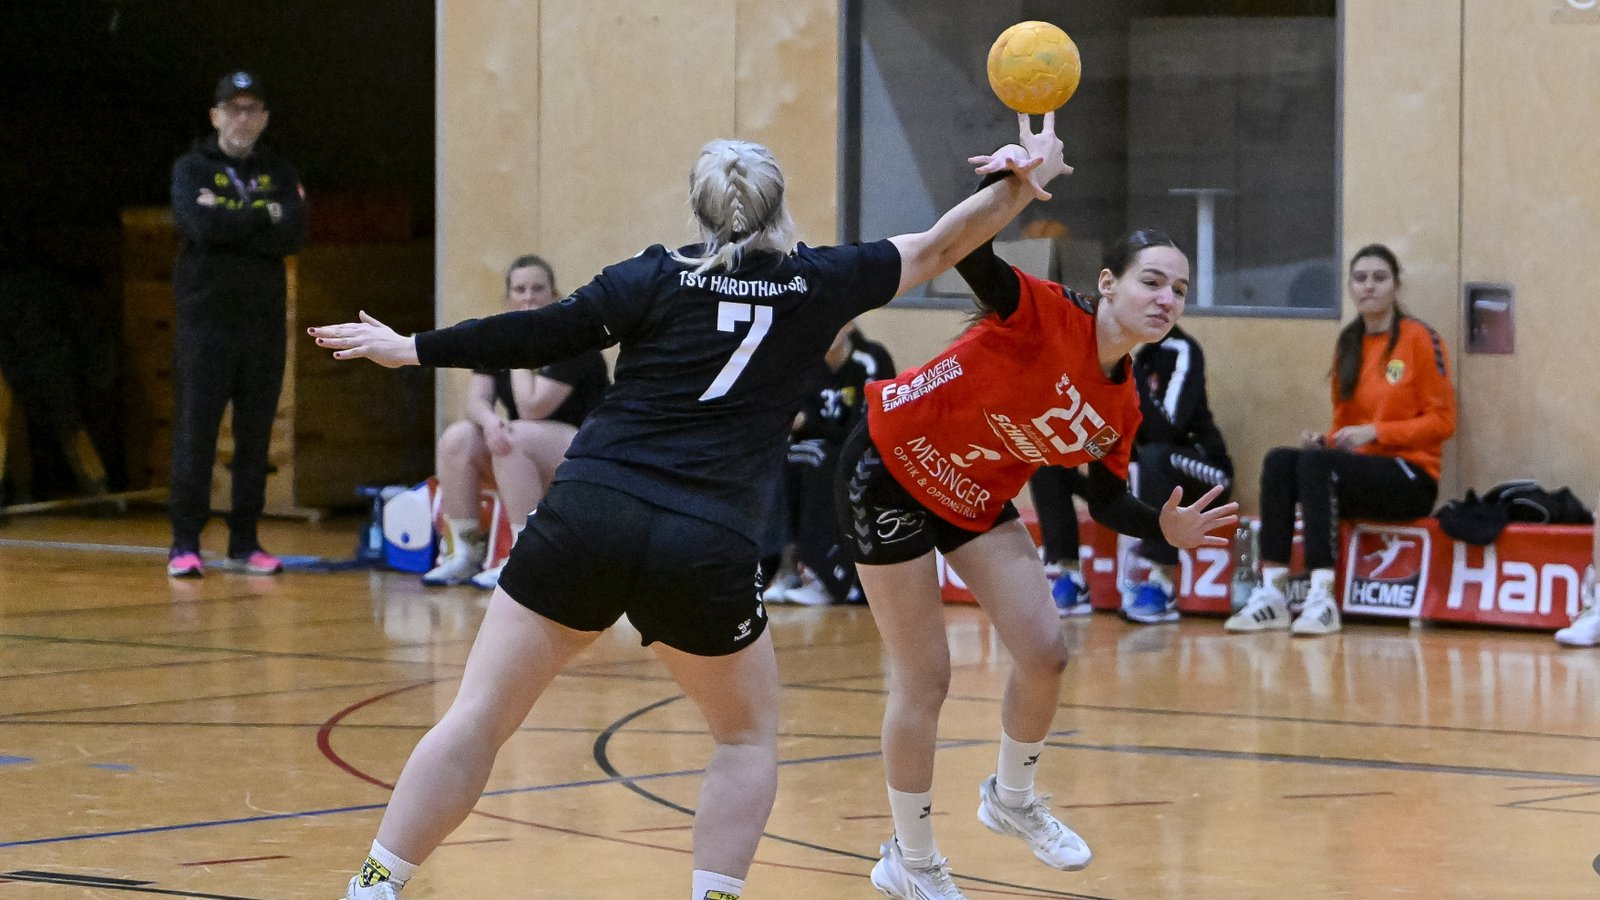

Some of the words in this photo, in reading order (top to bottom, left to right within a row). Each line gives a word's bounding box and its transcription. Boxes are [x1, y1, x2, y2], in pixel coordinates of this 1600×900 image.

[679, 270, 708, 289] TSV
[697, 301, 774, 402] 7
[882, 367, 964, 413] ZIMMERMANN
[1030, 384, 1106, 455] 25
[893, 446, 920, 478] OPTIK
[916, 477, 928, 488] &
[906, 435, 991, 512] MESINGER
[1350, 579, 1416, 608] HCME
